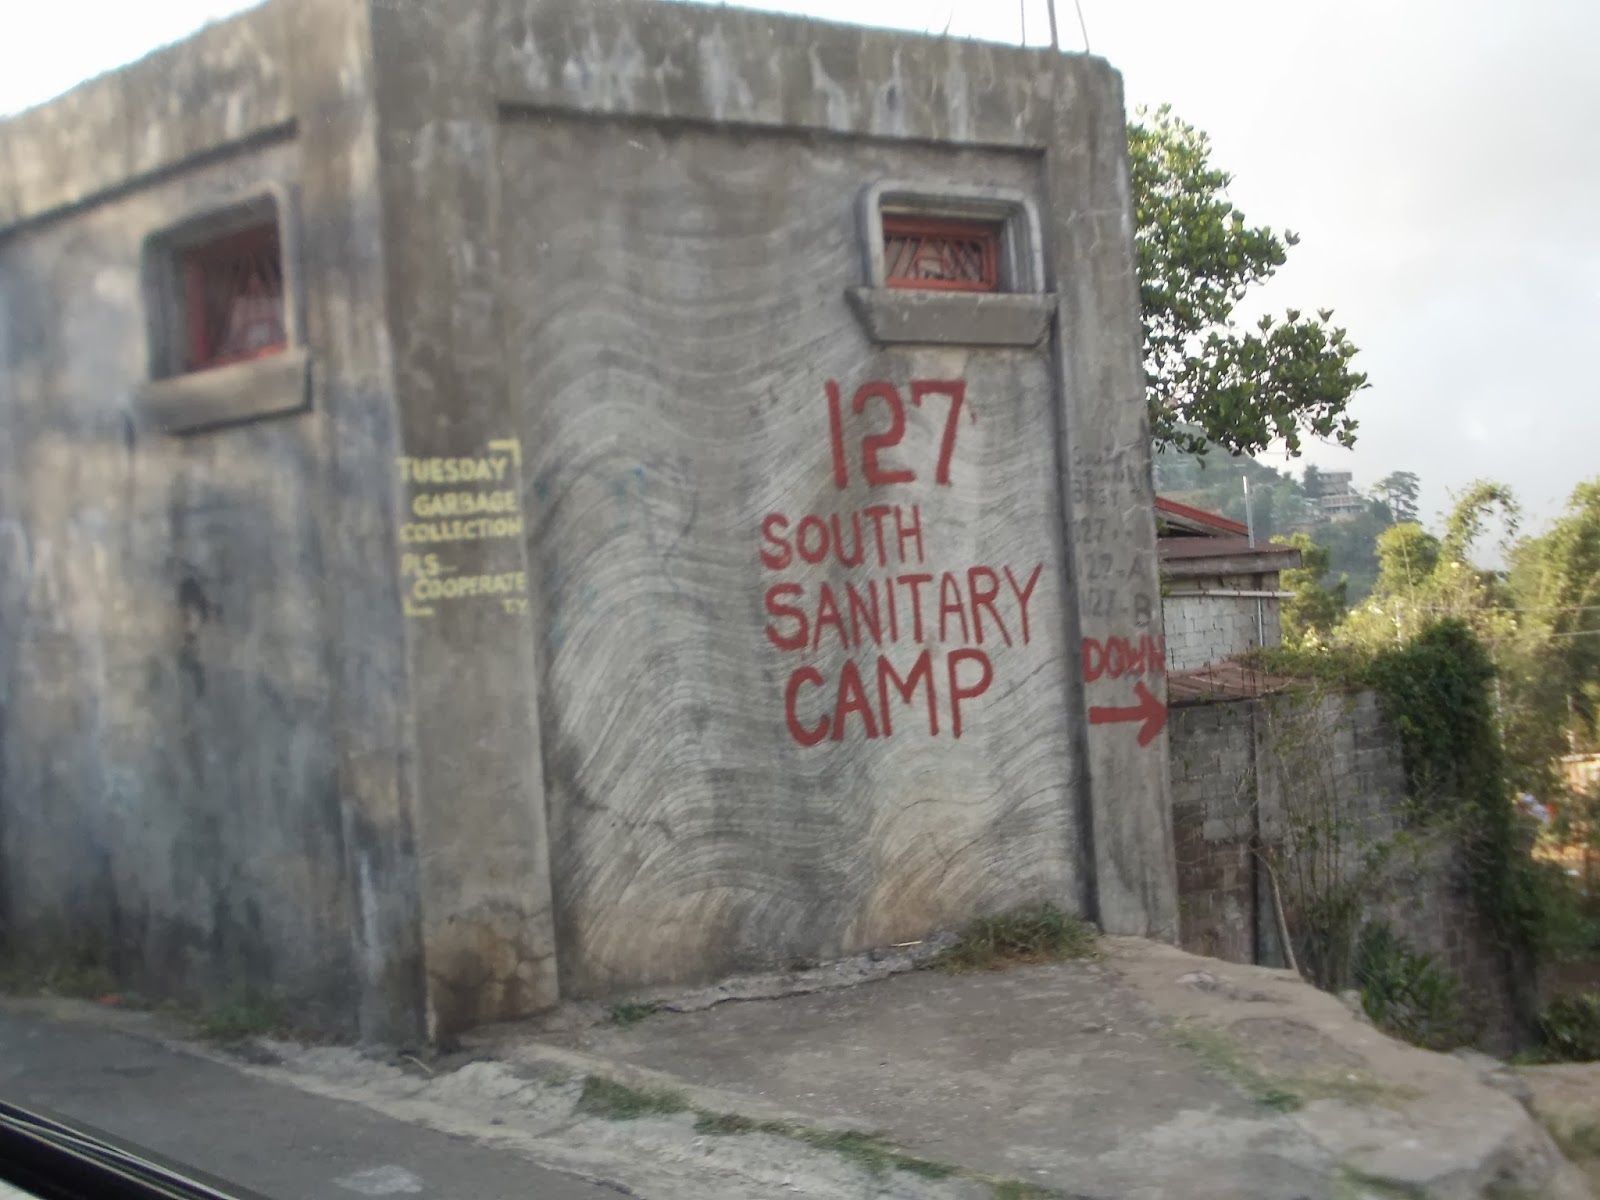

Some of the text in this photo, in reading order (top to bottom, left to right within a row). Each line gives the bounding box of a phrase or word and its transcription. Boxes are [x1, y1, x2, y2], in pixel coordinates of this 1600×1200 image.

[824, 379, 967, 491] 127
[397, 456, 509, 483] TUESDAY
[412, 491, 518, 518] GARBAGE
[400, 518, 524, 544] COLLECTION
[759, 504, 924, 571] SOUTH
[413, 572, 526, 599] COOPERATE
[763, 562, 1044, 652] SANITARY
[1082, 633, 1166, 685] DOWN
[785, 648, 993, 747] CAMP
